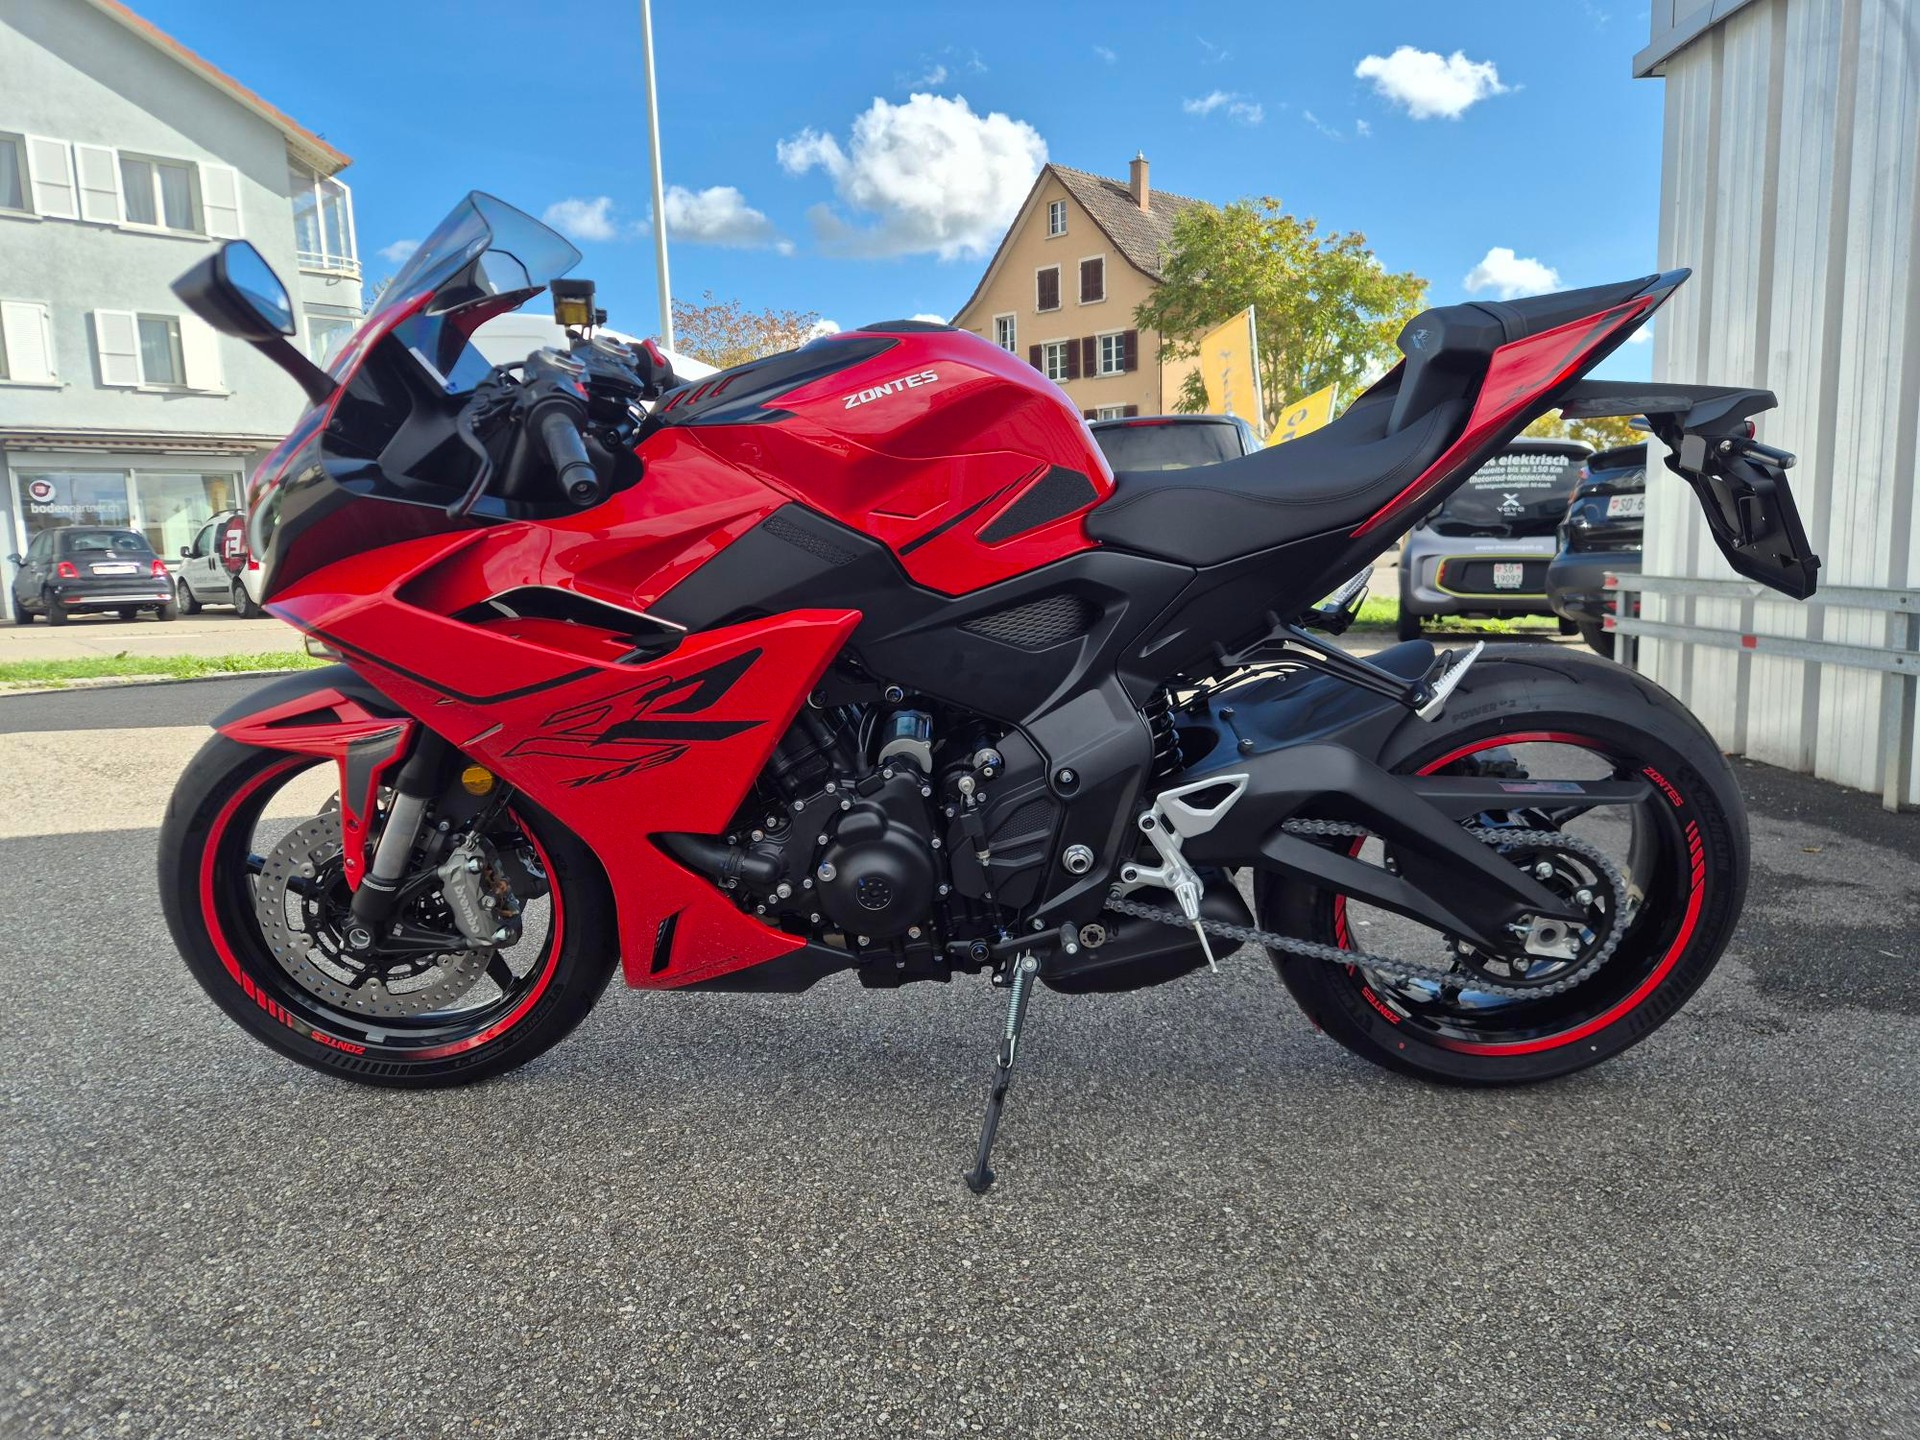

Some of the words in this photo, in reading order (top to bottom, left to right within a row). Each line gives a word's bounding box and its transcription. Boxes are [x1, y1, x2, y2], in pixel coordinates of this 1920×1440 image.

[842, 369, 939, 409] ZONTES
[1498, 454, 1569, 466] elektrisch
[1452, 702, 1498, 723] POWER
[1642, 766, 1684, 807] ZONTES
[453, 884, 481, 934] brembo
[1361, 986, 1402, 1025] ZONTES
[310, 1030, 366, 1055] ZONTES
